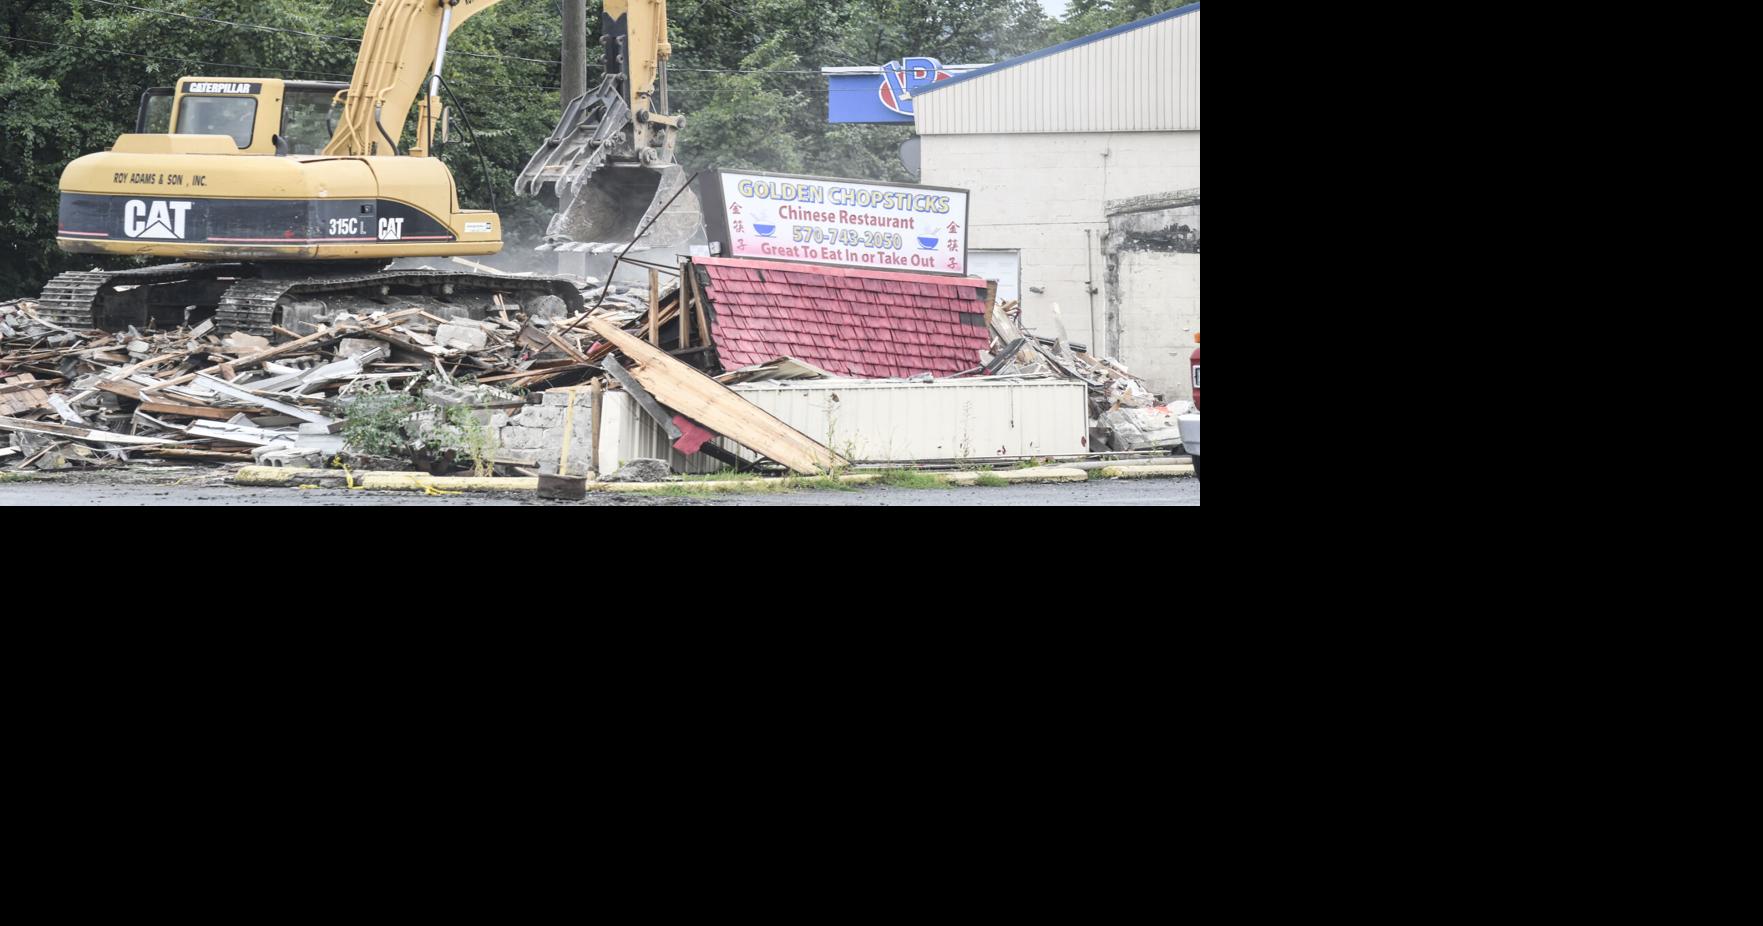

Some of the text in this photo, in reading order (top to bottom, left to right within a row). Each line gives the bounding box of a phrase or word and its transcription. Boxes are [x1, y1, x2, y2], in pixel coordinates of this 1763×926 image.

[189, 82, 251, 93] CATERPILLAR
[113, 172, 128, 184] ROY
[129, 173, 156, 185] ADAMS
[158, 174, 164, 184] &
[167, 174, 183, 185] SON
[192, 175, 208, 186] INC.
[738, 179, 950, 214] GOLDEN CHOPSTICKS
[124, 199, 192, 239] CAT
[329, 217, 358, 235] 315C
[378, 217, 404, 240] CAT
[778, 205, 915, 230] Chinese Restaurant
[792, 225, 903, 250] 570-743-2050
[760, 242, 935, 268] Great To Eat In or Take Out
